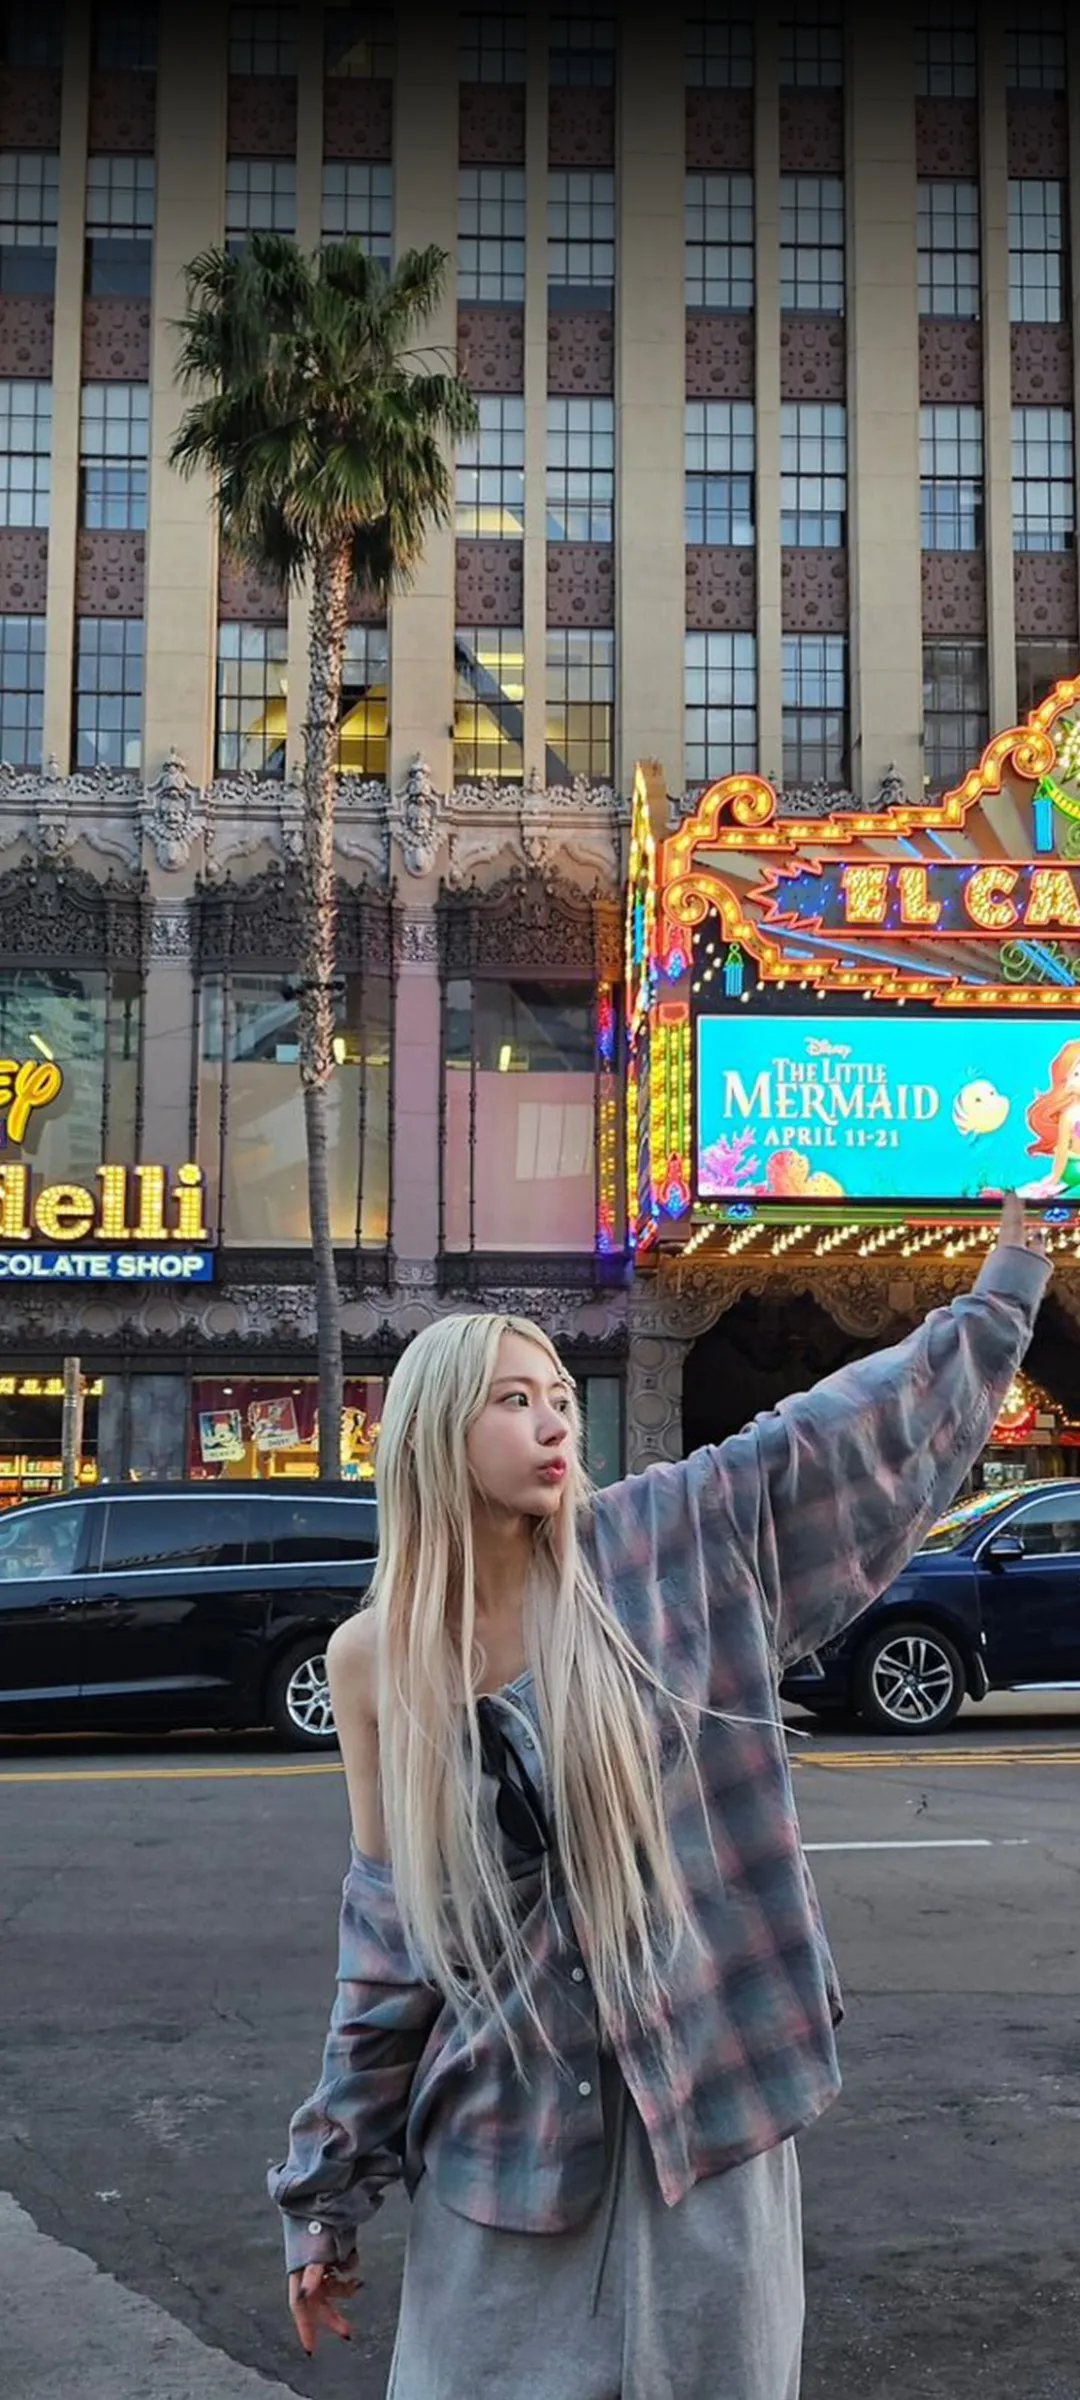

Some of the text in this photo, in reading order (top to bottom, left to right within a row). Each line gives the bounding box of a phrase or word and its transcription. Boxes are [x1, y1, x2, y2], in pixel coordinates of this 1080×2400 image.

[841, 864, 1080, 930] EL CA
[804, 1036, 852, 1059] Disney
[722, 1069, 940, 1126] MERMAID
[763, 1126, 900, 1148] APRIL 11-21
[116, 1254, 205, 1278] SHOP
